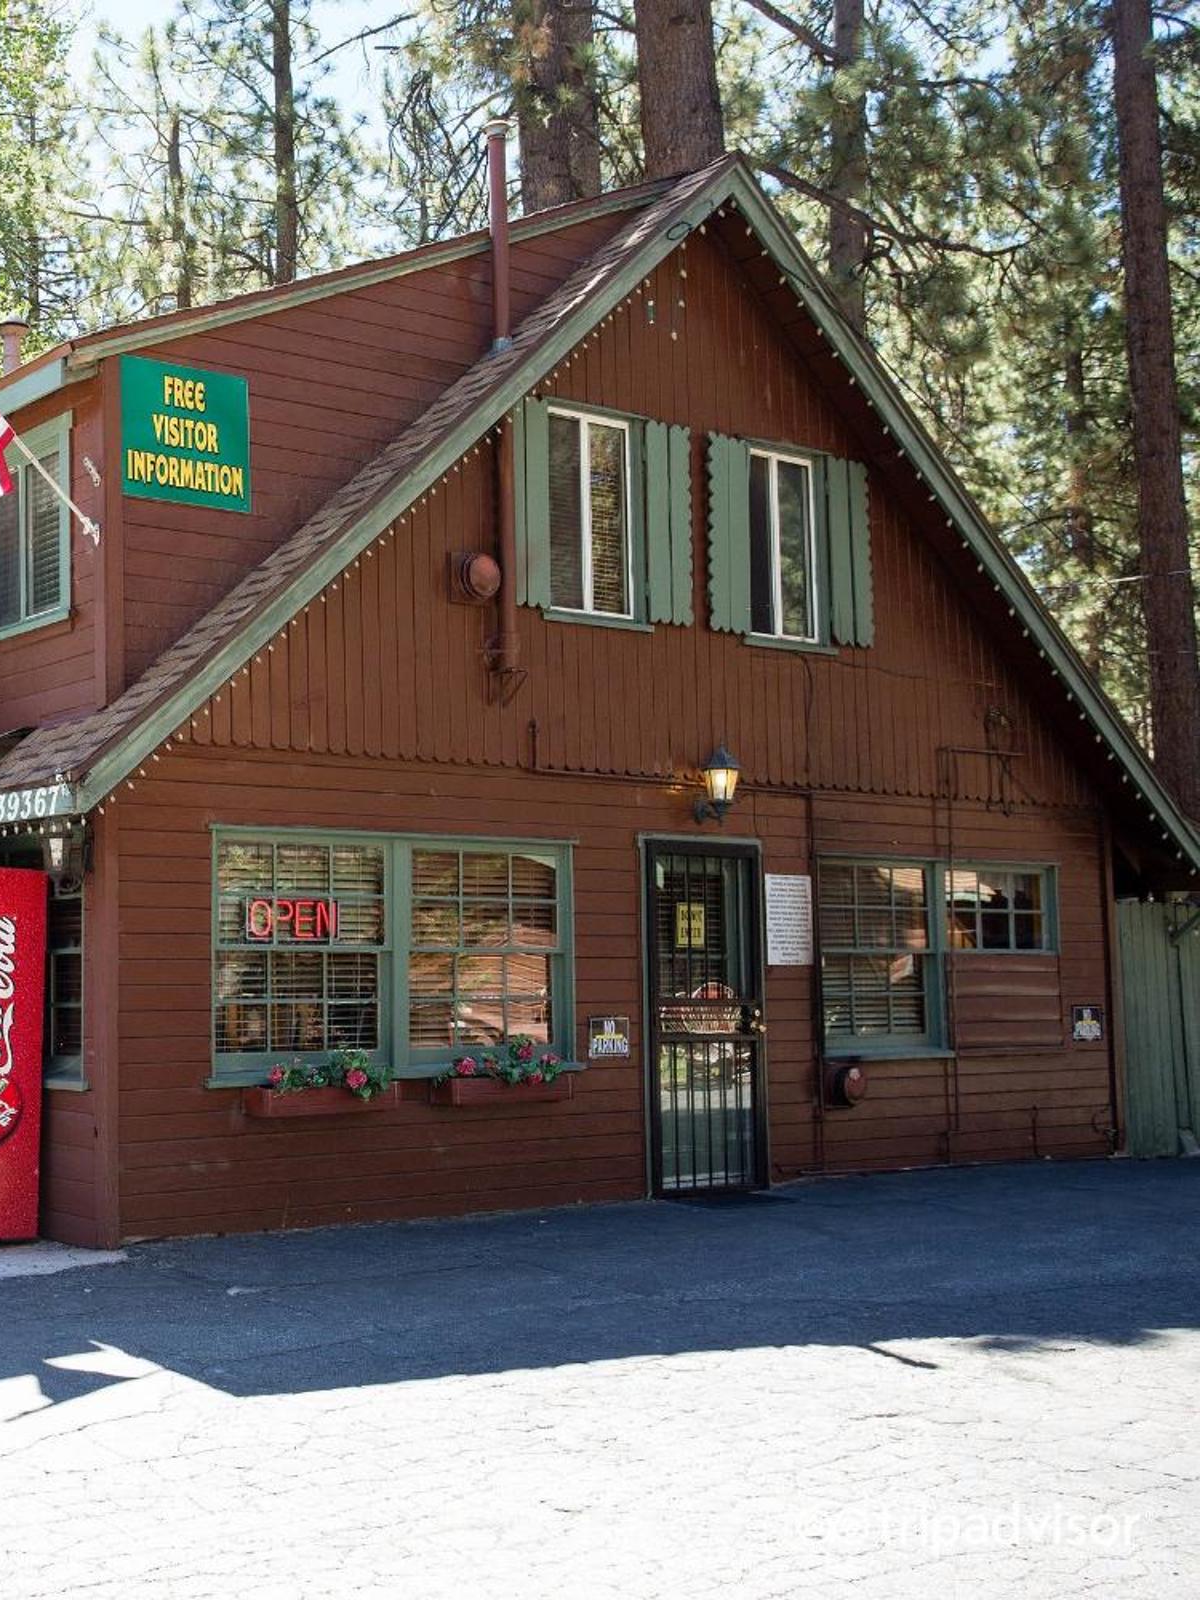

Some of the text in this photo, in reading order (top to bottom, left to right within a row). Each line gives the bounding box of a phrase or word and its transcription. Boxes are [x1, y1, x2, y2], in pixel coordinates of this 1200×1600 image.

[163, 375, 206, 412] FREE
[151, 413, 218, 453] VISITOR
[126, 449, 244, 499] INFORMATION
[248, 899, 338, 939] OPEN
[592, 1037, 628, 1053] PARKING
[604, 1020, 615, 1034] NO
